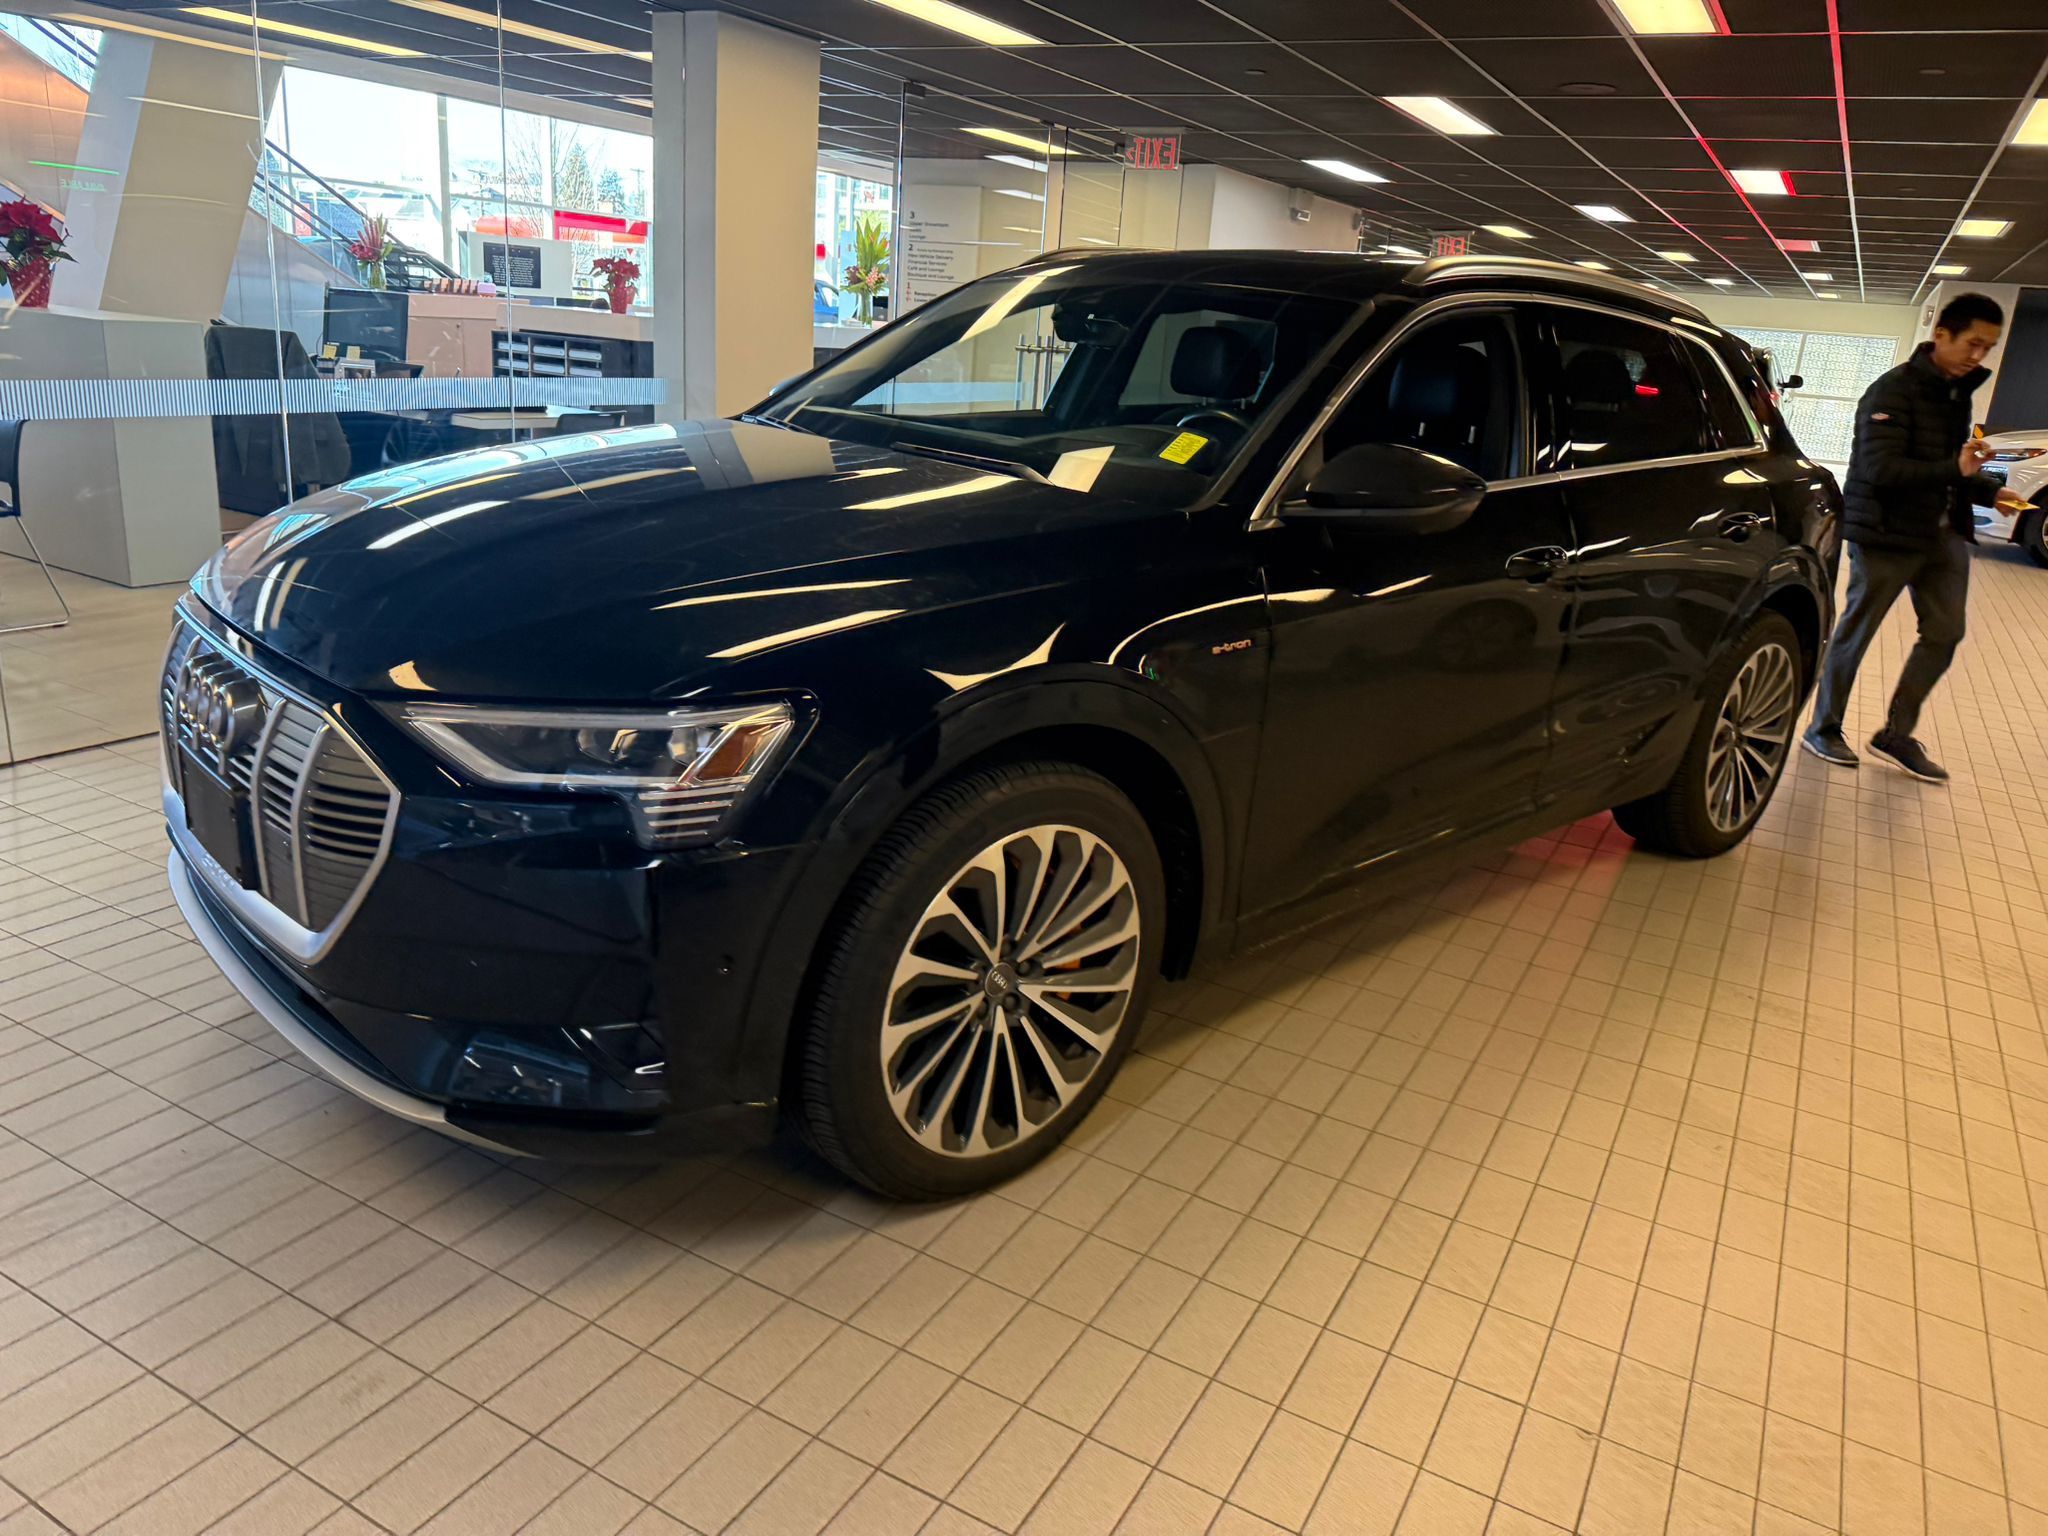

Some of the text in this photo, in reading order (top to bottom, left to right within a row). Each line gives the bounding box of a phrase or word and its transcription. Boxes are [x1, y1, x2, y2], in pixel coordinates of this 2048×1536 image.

[910, 211, 915, 219] 3
[908, 243, 914, 251] 2
[1212, 639, 1251, 654] e-tron
